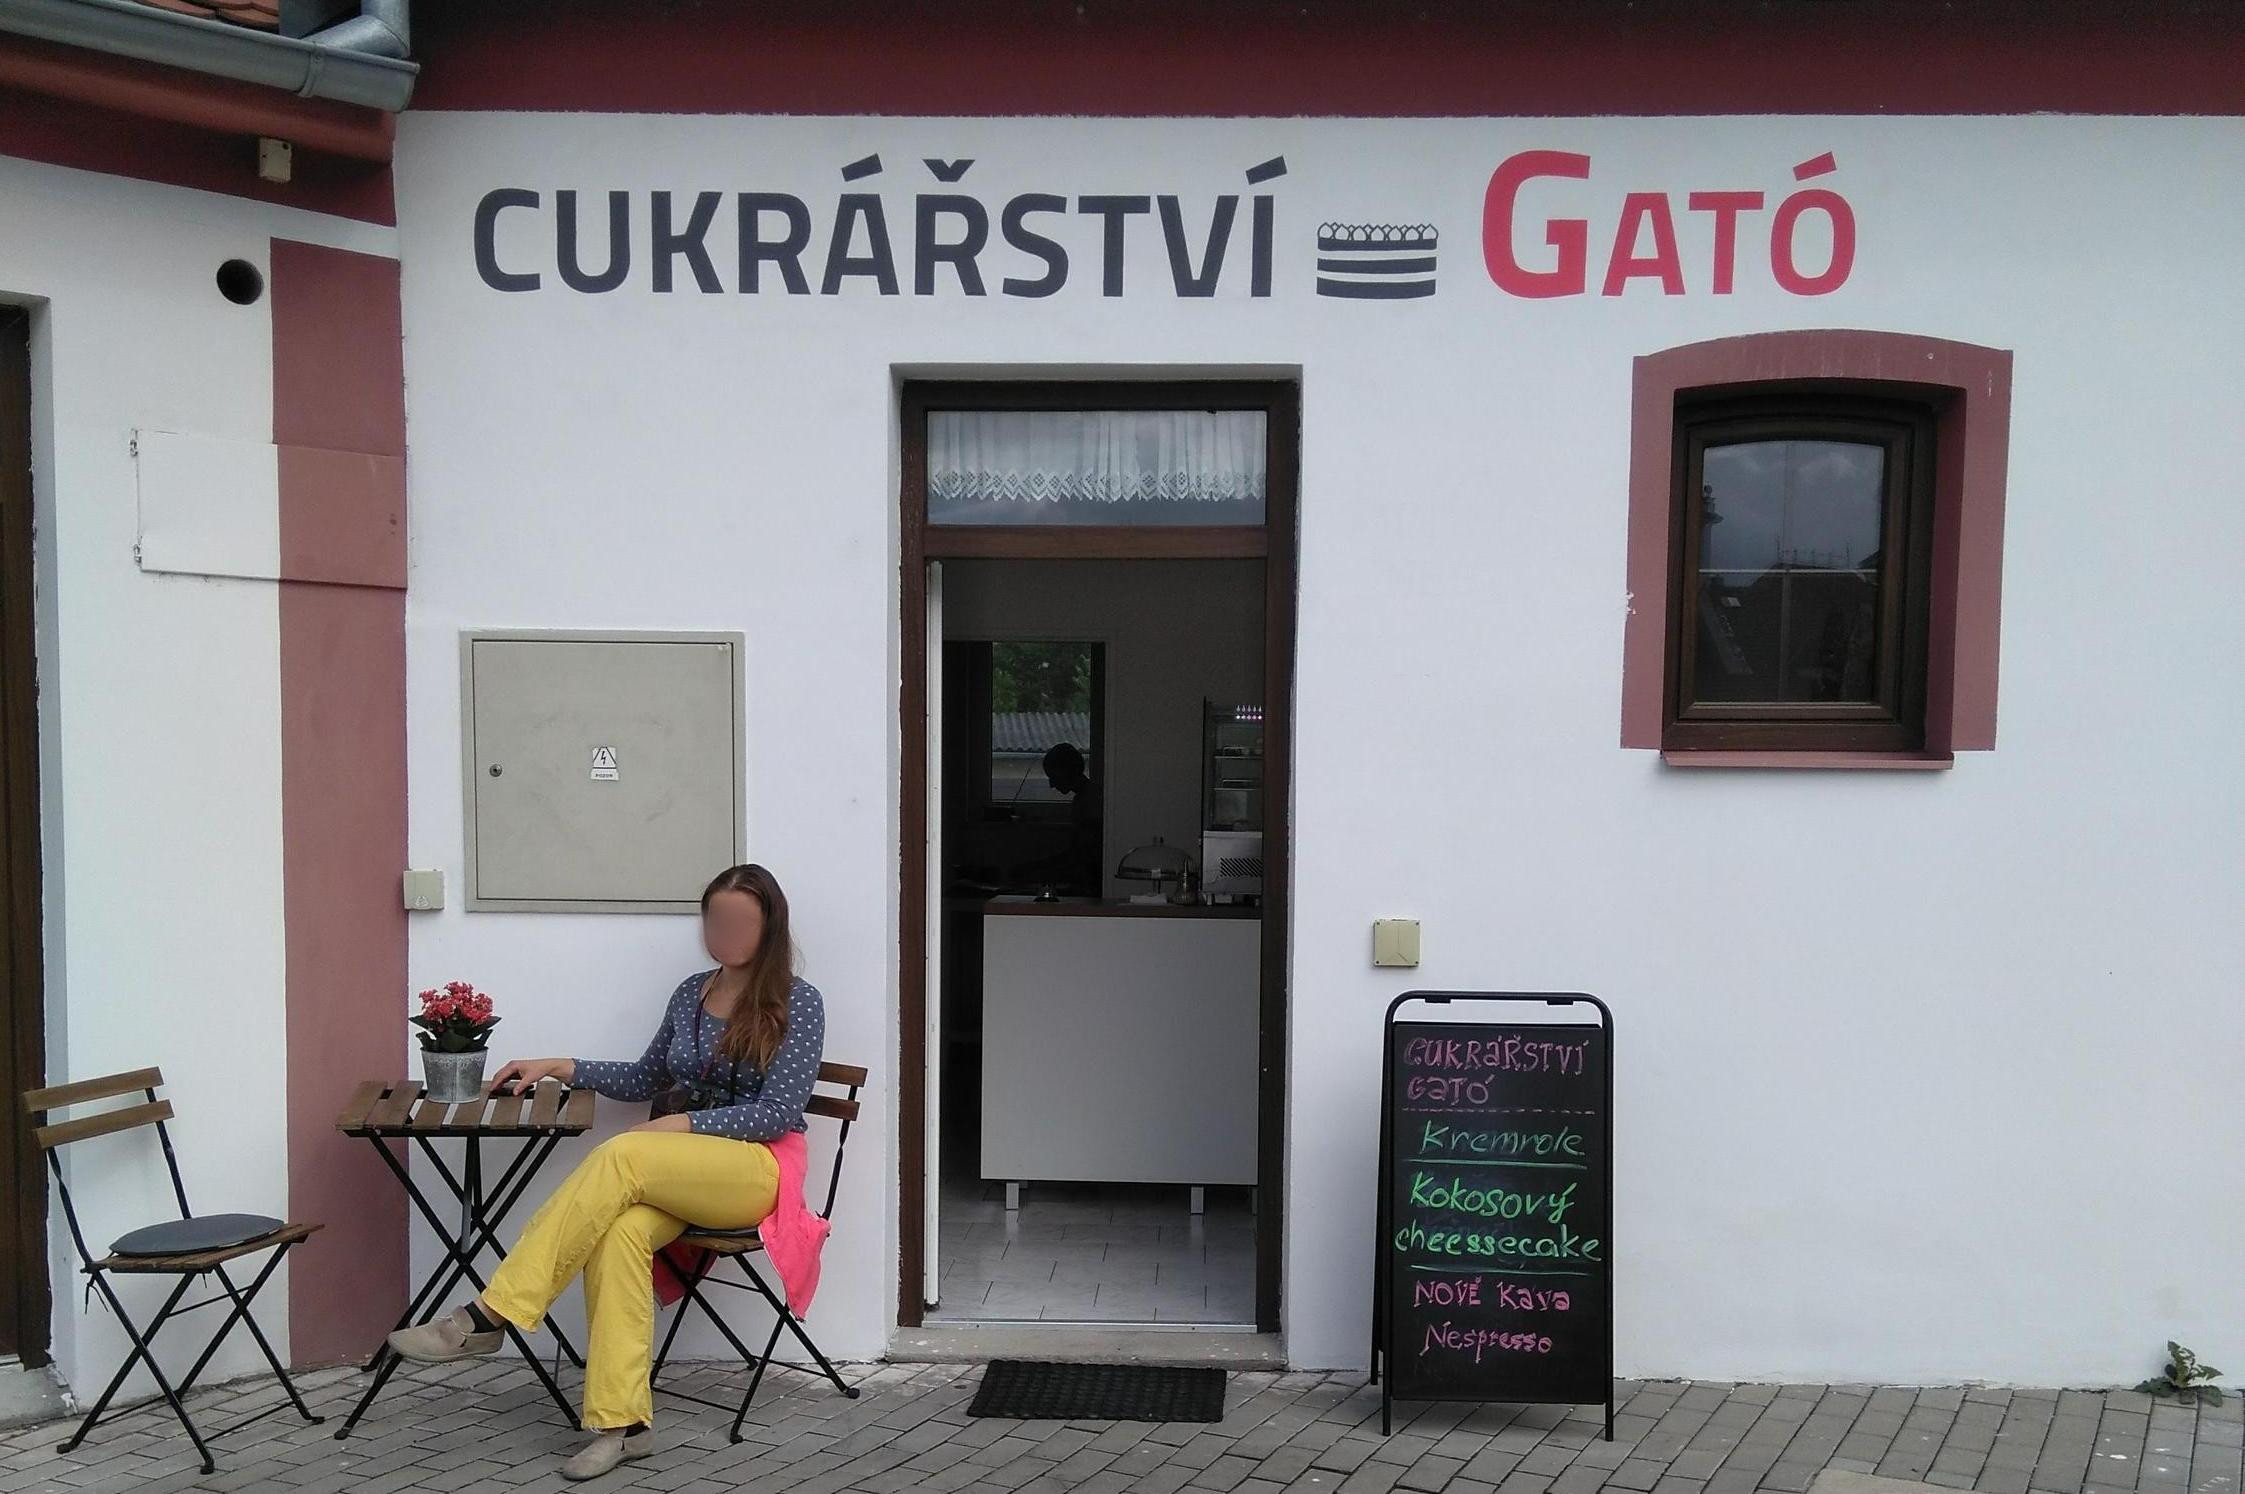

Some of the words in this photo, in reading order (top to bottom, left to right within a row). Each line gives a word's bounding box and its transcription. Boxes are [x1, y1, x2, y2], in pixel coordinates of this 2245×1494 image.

[474, 152, 1288, 298] CUKRÁŘSTVÍ
[1482, 150, 1857, 299] GATÓ
[1419, 1119, 1586, 1156] Kremrole
[1410, 1171, 1578, 1224] Kokosový
[1394, 1219, 1602, 1262] cheessecake
[1418, 1320, 1553, 1365] Nespresso
